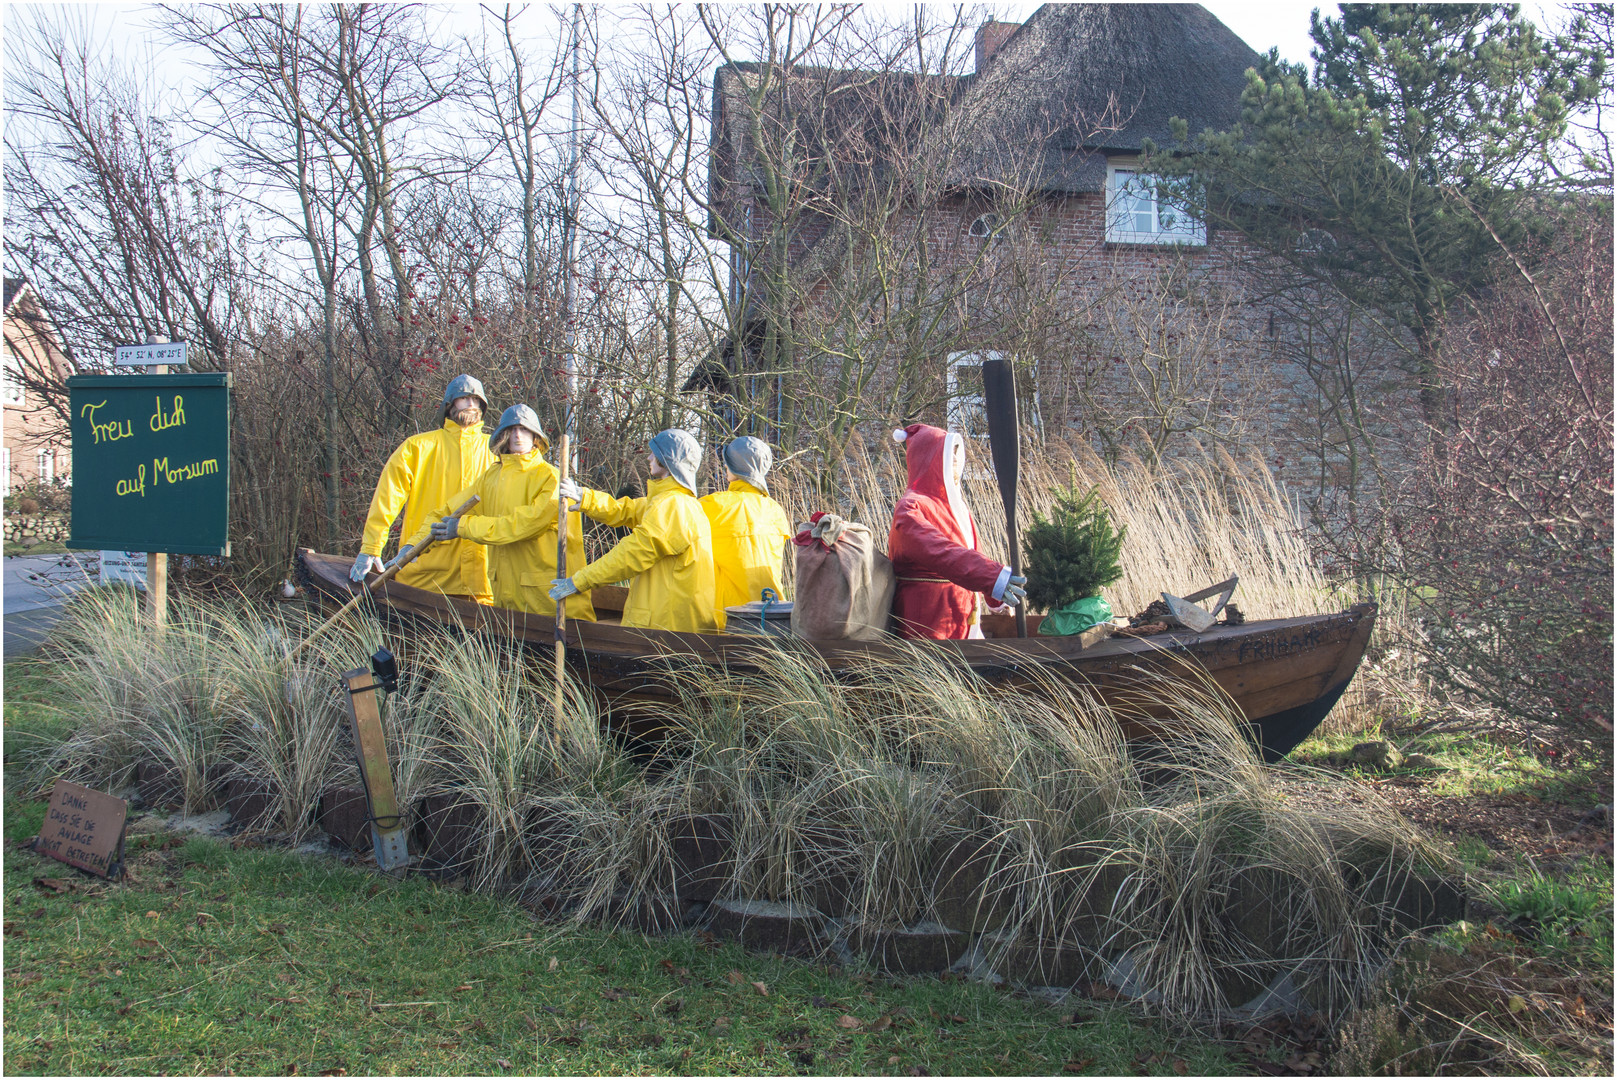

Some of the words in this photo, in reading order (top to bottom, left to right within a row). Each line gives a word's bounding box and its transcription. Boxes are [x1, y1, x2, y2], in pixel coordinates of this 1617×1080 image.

[81, 399, 134, 444] Freu
[150, 395, 187, 432] dich
[116, 463, 146, 497] auf
[153, 457, 219, 486] Morsum
[61, 792, 88, 811] DANKE
[50, 808, 68, 823] DASS
[57, 827, 94, 846] ANLAGE
